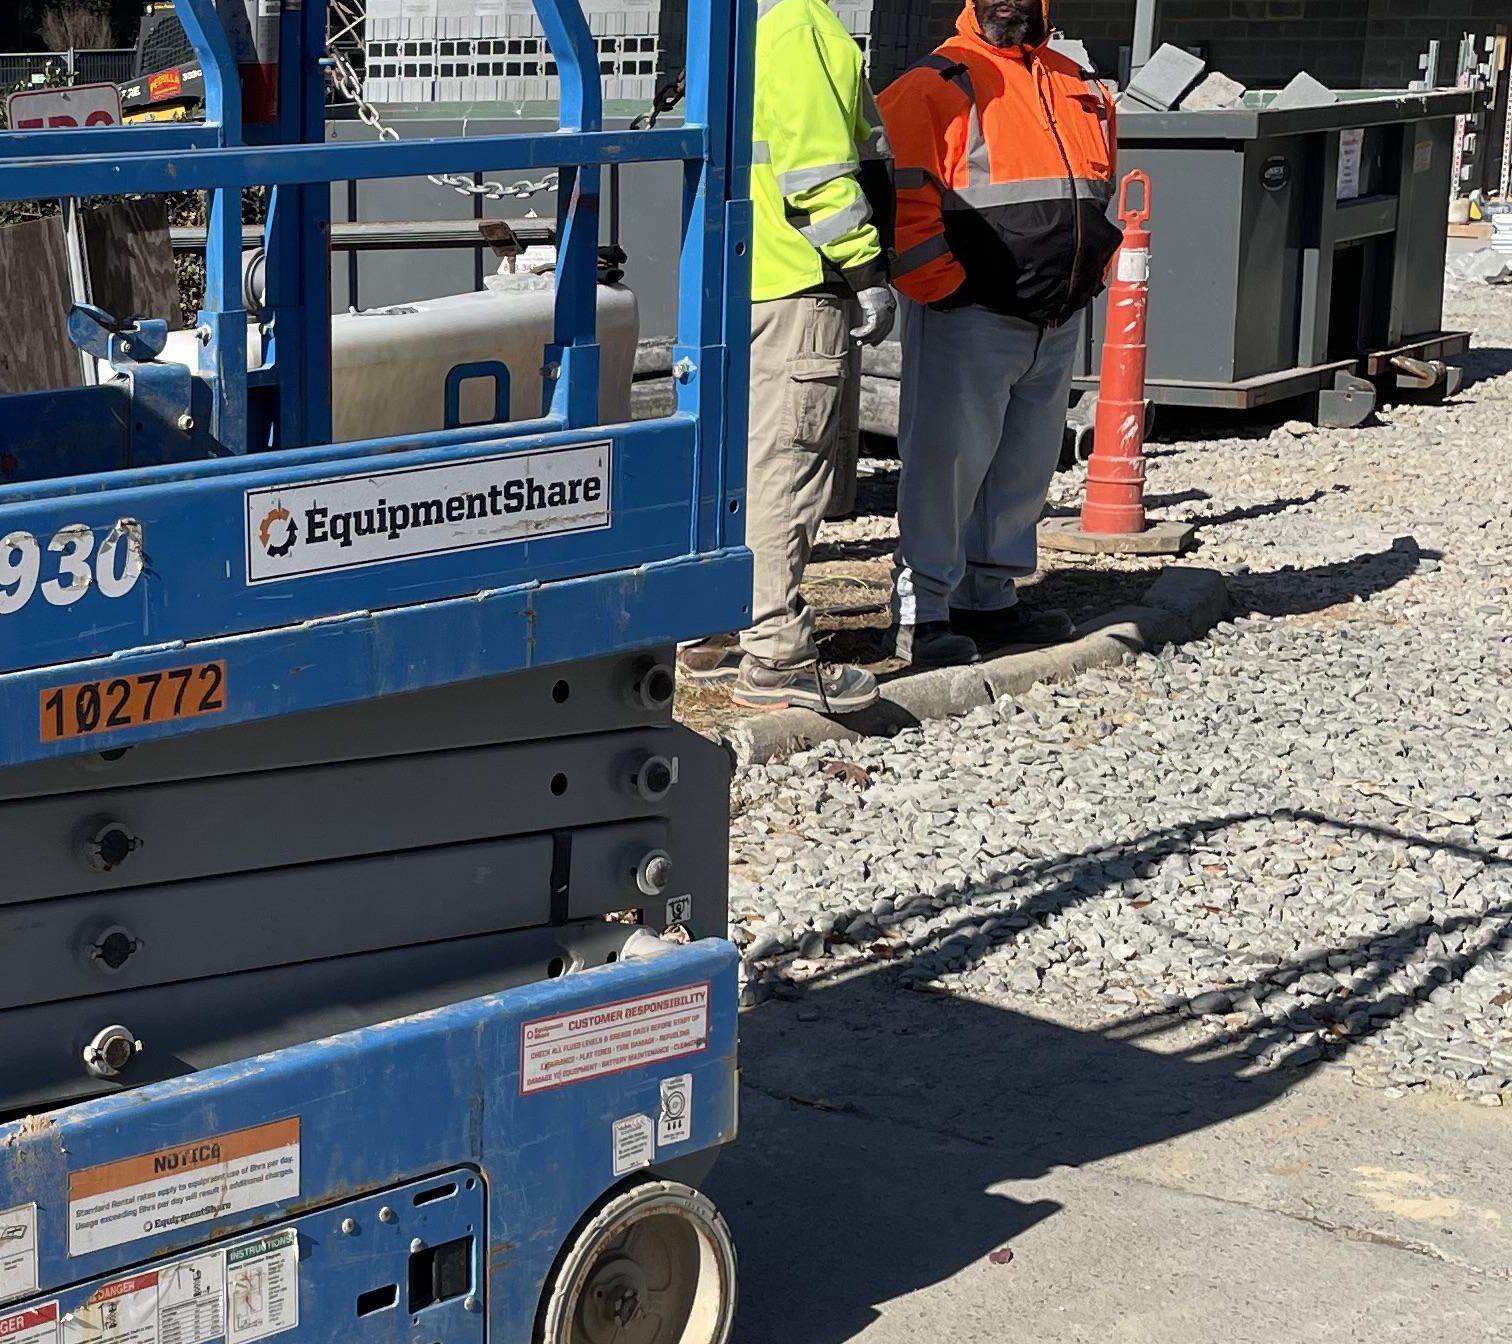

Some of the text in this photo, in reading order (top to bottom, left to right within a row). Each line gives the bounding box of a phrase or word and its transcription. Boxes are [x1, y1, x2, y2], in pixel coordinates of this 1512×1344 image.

[304, 475, 602, 549] EquipmentShare
[45, 663, 223, 737] 102772
[568, 990, 705, 1031] CUSTOMER RESPONSIBILITY
[76, 1201, 110, 1217] Standard
[111, 1195, 134, 1208] Rental
[137, 1190, 155, 1201] rates
[157, 1185, 176, 1198] apply
[179, 1182, 186, 1191] to
[241, 1166, 248, 1175] of
[267, 1160, 277, 1169] per
[76, 1218, 98, 1232] Usage
[99, 1207, 137, 1225] exceeding
[157, 1200, 168, 1210] per
[170, 1196, 183, 1207] day
[185, 1192, 197, 1201] will
[198, 1186, 219, 1198] result
[229, 1174, 263, 1189] additional
[230, 1235, 296, 1261] INSTRUCTIONS
